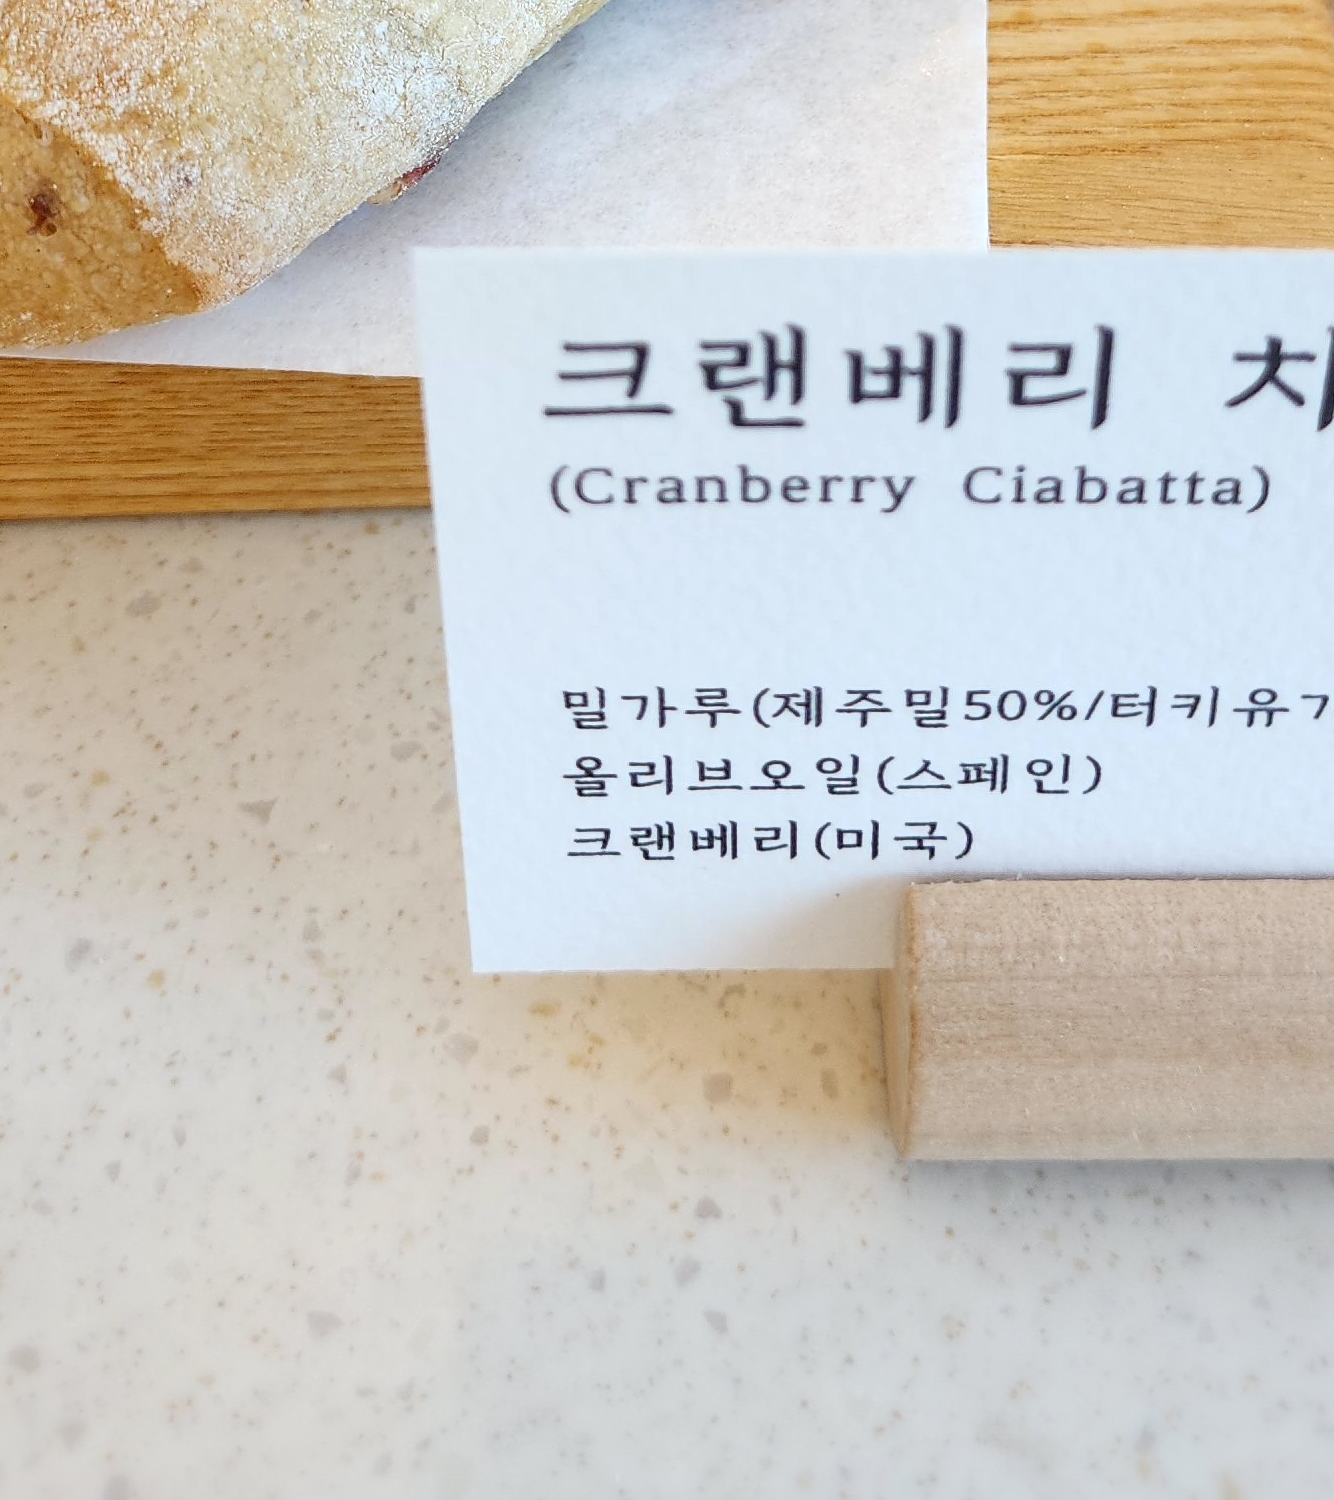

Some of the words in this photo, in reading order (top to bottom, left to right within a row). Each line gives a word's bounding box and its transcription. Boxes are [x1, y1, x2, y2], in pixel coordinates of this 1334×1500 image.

[543, 323, 1116, 430] 크랜베리
[550, 465, 915, 514] (Cranberry
[963, 465, 1271, 514] Ciabatta)
[562, 753, 1103, 798] 올리브오일(스페인)
[567, 819, 975, 861] 크랜베리(미국)
